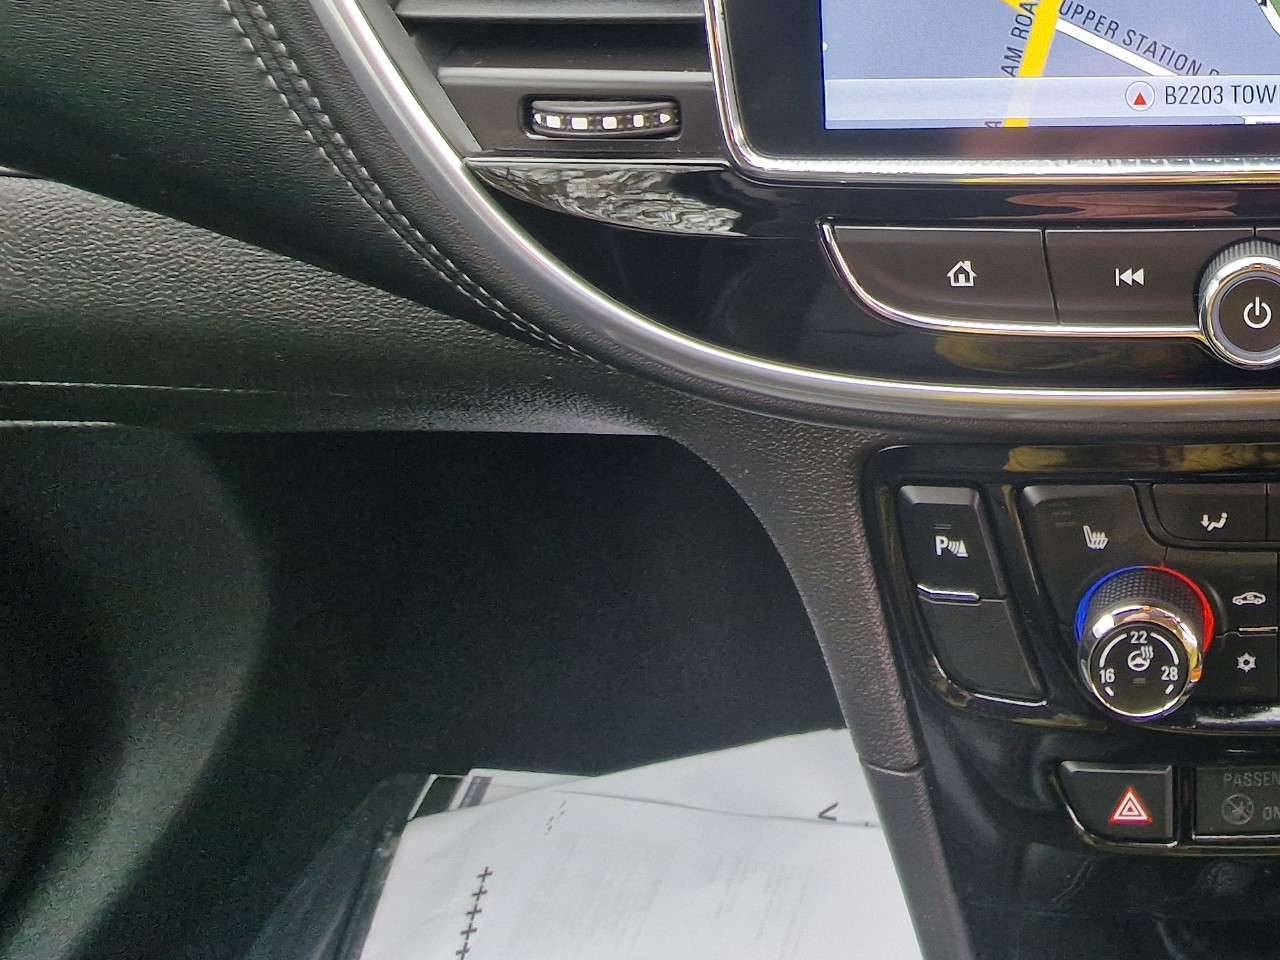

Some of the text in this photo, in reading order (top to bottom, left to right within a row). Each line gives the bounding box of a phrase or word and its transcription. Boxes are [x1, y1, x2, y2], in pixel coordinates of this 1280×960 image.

[1121, 28, 1202, 76] STATION
[1164, 84, 1224, 105] B2203
[1130, 631, 1148, 645] 22
[1100, 668, 1116, 684] 16
[1160, 666, 1179, 682] 28
